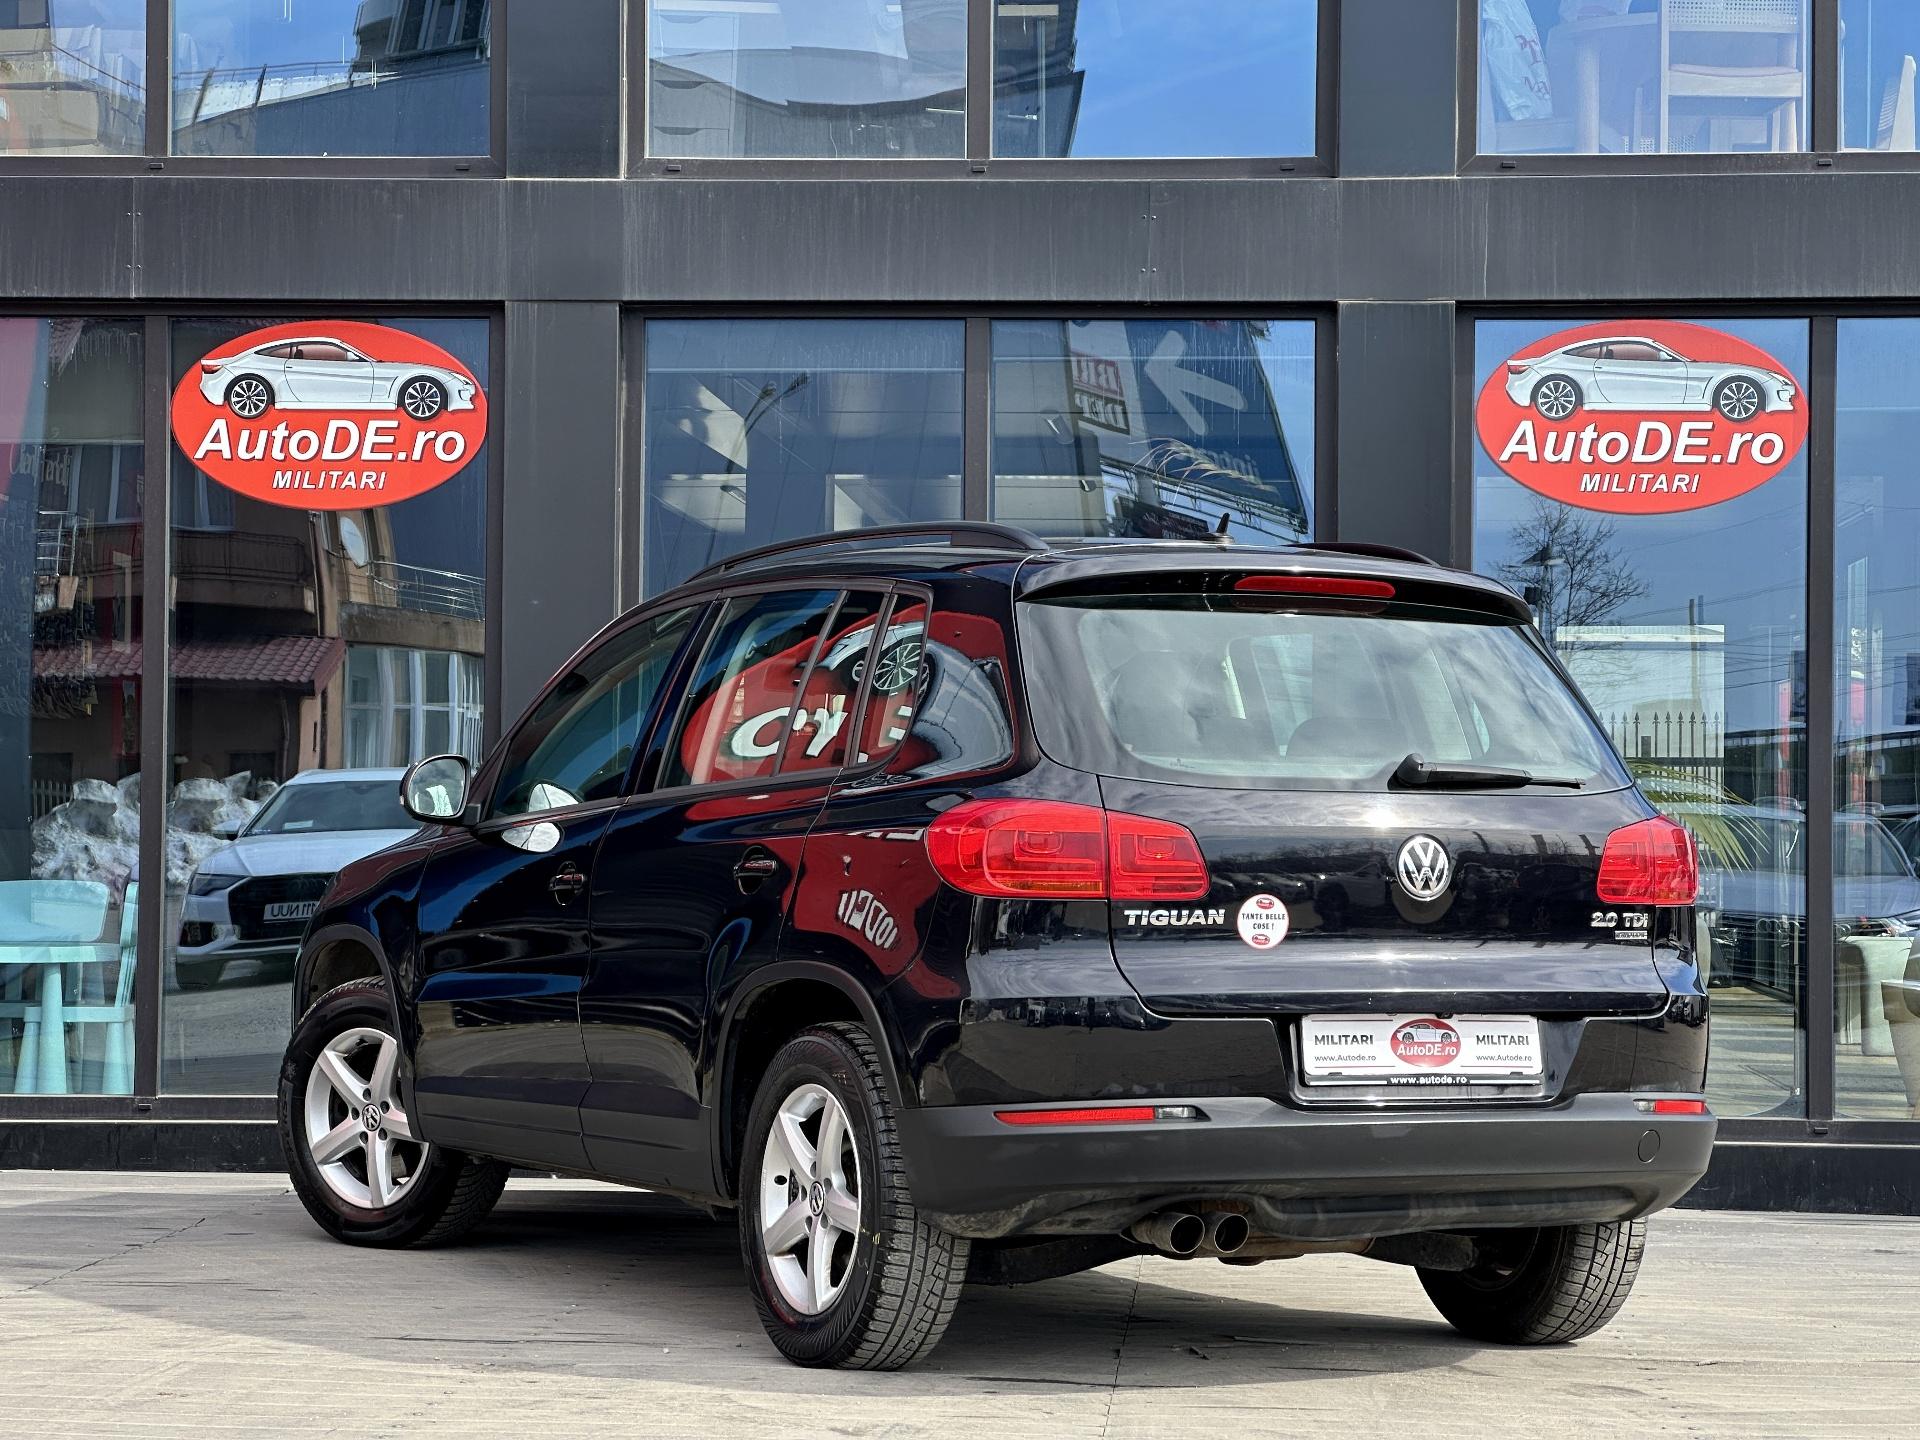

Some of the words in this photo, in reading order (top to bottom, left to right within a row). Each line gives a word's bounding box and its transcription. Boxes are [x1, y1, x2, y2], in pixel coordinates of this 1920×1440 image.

[194, 418, 466, 462] AutoDE.ro
[1499, 420, 1784, 465] AutoDE.ro
[272, 470, 386, 490] MILITARI
[1579, 473, 1700, 493] MILITARI
[1124, 909, 1226, 926] TIGUAN
[1623, 912, 1649, 928] TDI
[1253, 922, 1270, 930] COSE
[1314, 1034, 1374, 1046] MILITARI
[1476, 1034, 1530, 1046] MILITARI
[1397, 1043, 1457, 1057] AutoDE.ro
[1314, 1053, 1377, 1063] www.Autode.ro
[1476, 1053, 1533, 1063] www.Autode.ro
[1390, 1075, 1468, 1085] www.autode.ro
